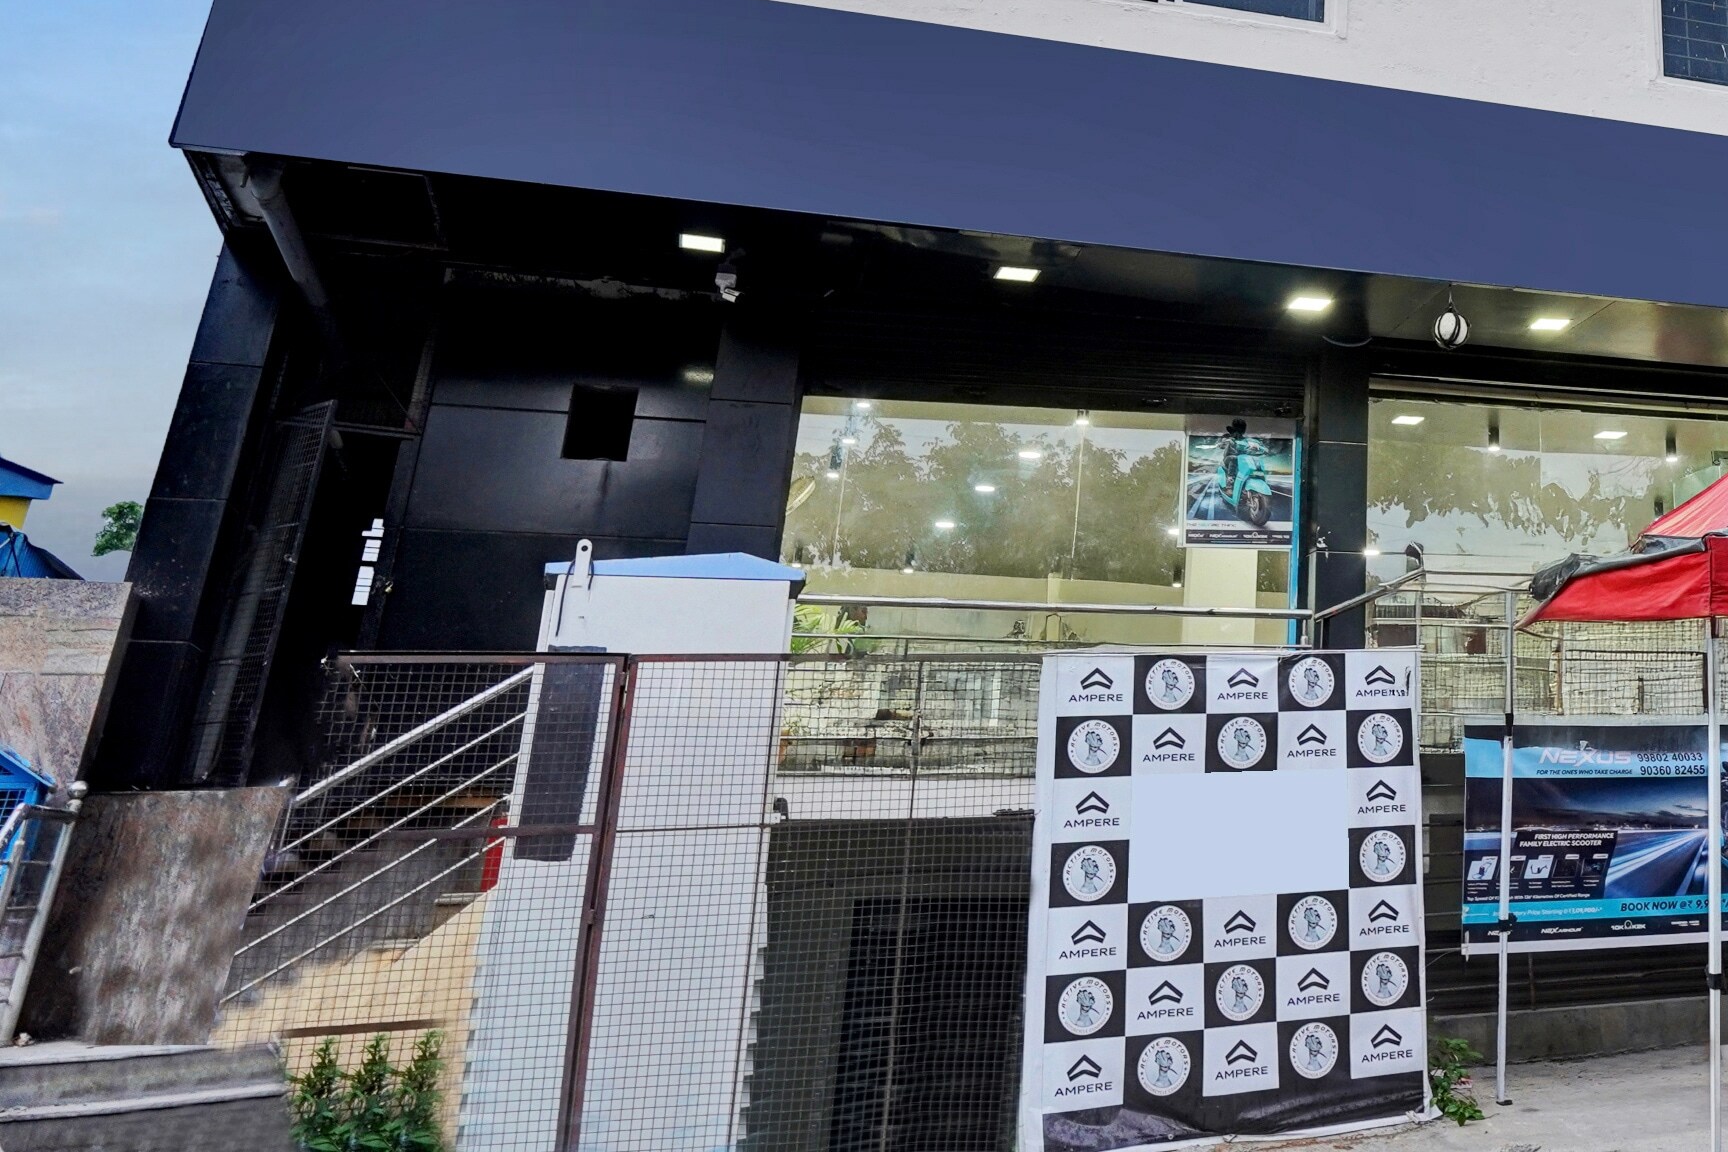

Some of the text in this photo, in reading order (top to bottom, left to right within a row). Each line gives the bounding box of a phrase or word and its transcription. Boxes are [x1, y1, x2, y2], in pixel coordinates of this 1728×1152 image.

[1149, 662, 1165, 684] ACTIVE
[1292, 661, 1308, 682] ACTIVE
[1069, 694, 1123, 702] AMPERE
[1218, 692, 1268, 700] AMPERE
[1071, 723, 1090, 747] ACTIVE
[1221, 721, 1238, 743] ACTIVE
[1360, 716, 1376, 739] ACTIVE
[1143, 753, 1194, 762] AMPERE
[1287, 747, 1336, 757] AMPERE
[1539, 746, 1703, 767] NEXUS 99802 40033
[1640, 765, 1706, 776] 90360 82455
[1358, 805, 1406, 814] AMPERE
[1064, 818, 1119, 828] AMPERE
[1362, 834, 1377, 858] ACTIVE
[1067, 849, 1086, 875] ACTIVE
[1291, 900, 1308, 924] ACTIVE
[1620, 902, 1652, 912] BOOK
[1652, 901, 1677, 910] NOW
[1143, 910, 1162, 935] ACTIVE
[1360, 924, 1409, 936] AMPERE
[1214, 935, 1266, 947] AMPERE
[1059, 947, 1116, 959] AMPERE
[1364, 956, 1380, 981] ACTIVE
[1219, 969, 1236, 994] ACTIVE
[1062, 981, 1082, 1008] ACTIVE
[1287, 994, 1340, 1006] AMPERE
[1137, 1007, 1193, 1020] AMPERE
[1293, 1026, 1309, 1053] ACTIVE
[1141, 1041, 1160, 1069] ACTIVE
[1362, 1050, 1412, 1063] AMPERE
[1215, 1066, 1267, 1080] AMPERE
[1055, 1081, 1112, 1096] AMPERE
